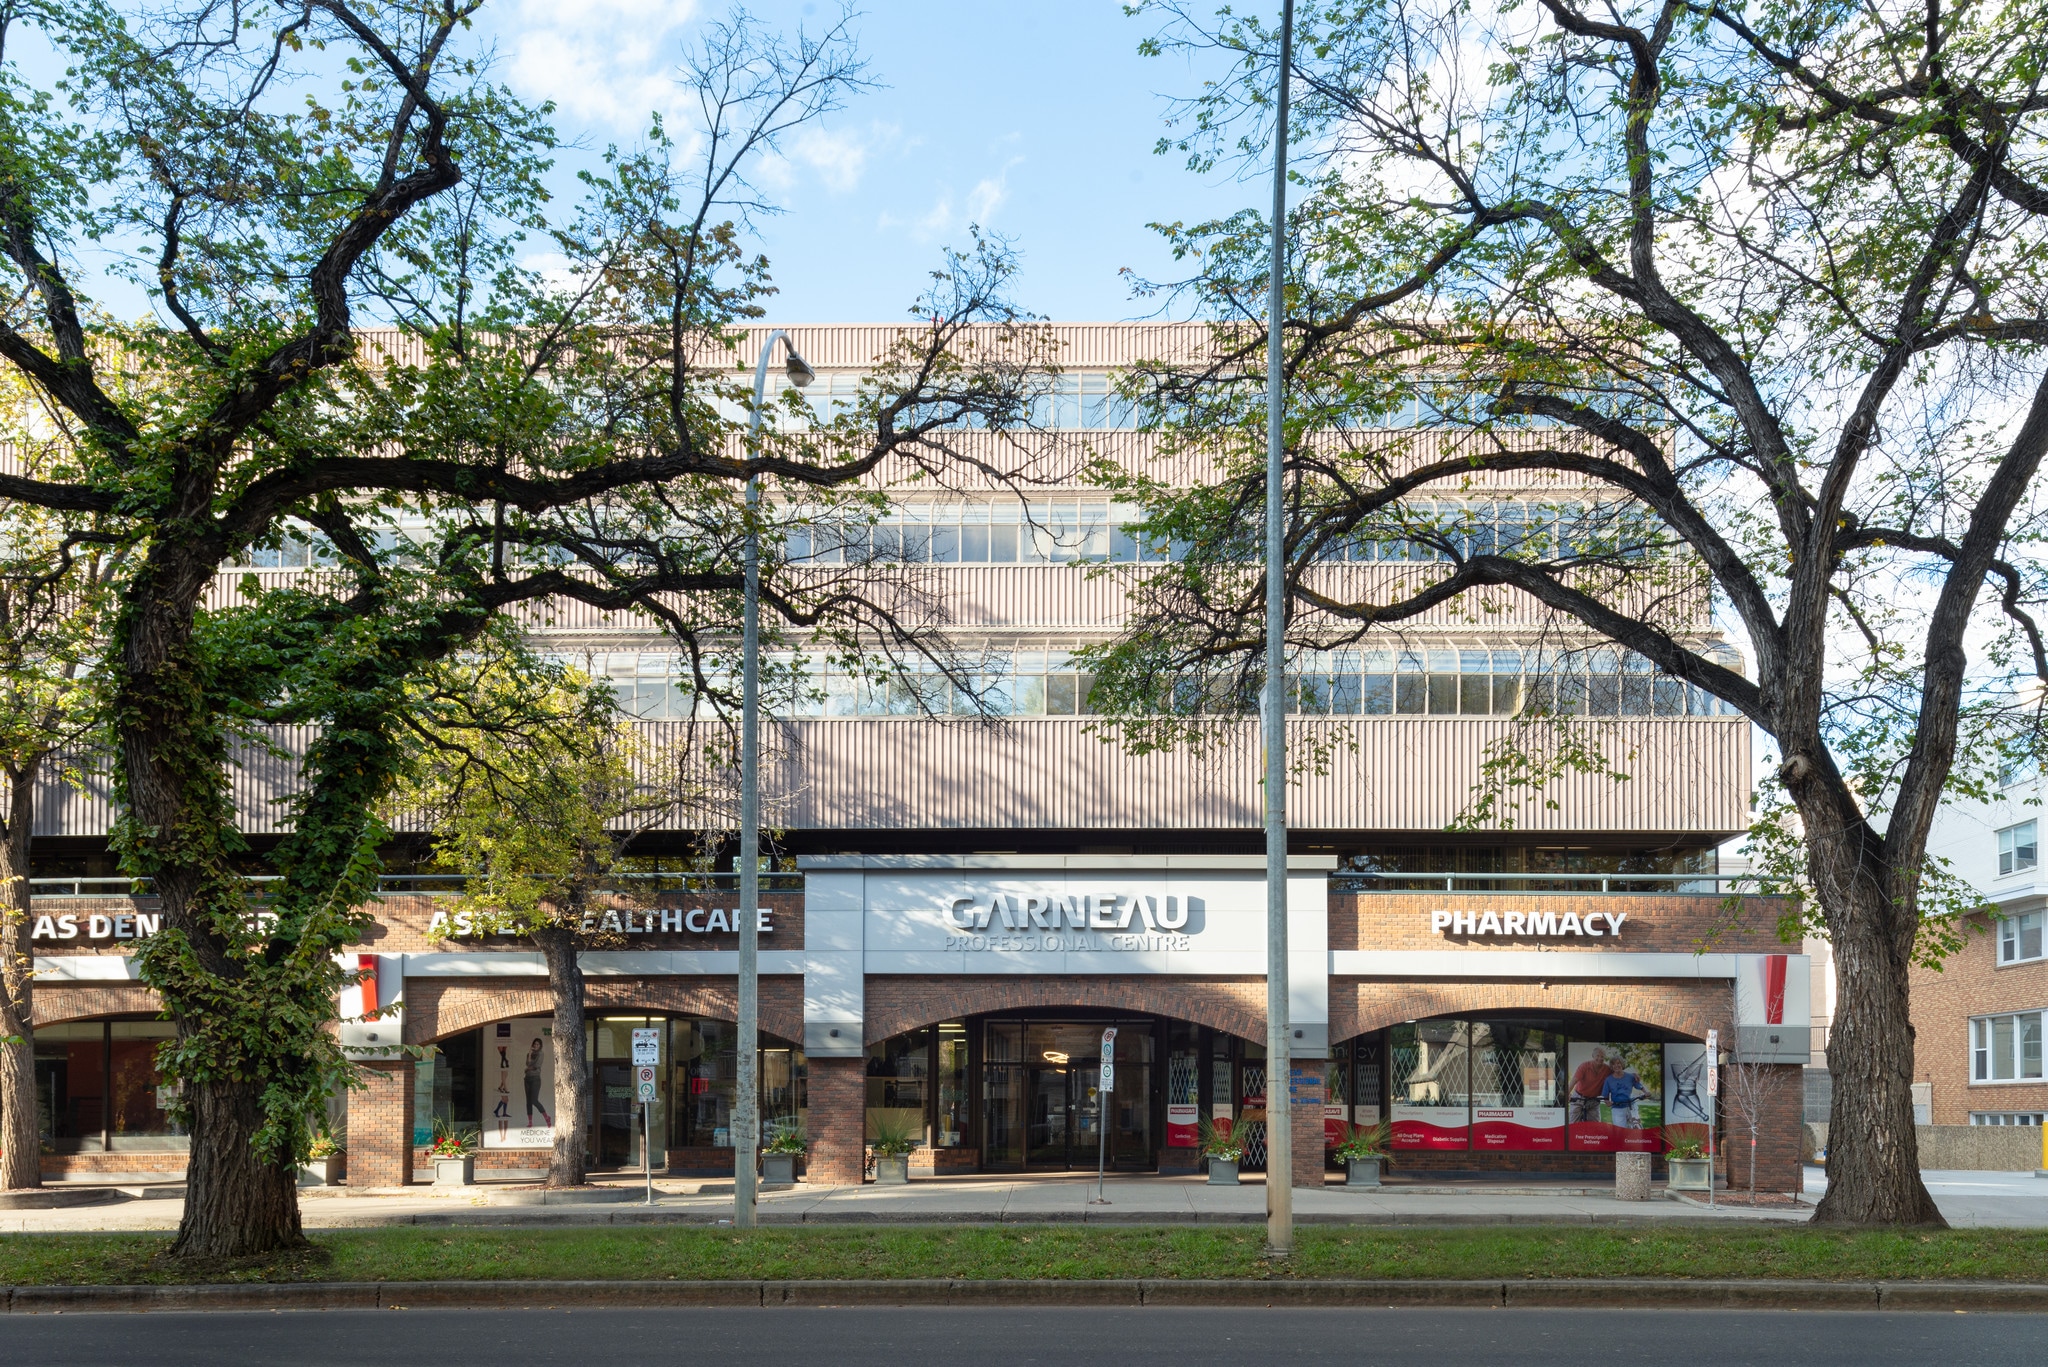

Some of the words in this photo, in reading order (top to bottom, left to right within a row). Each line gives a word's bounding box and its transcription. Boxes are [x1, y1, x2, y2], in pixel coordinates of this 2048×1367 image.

[579, 908, 774, 933] EALTHCAE
[942, 893, 1188, 930] GARNEAU
[1431, 911, 1627, 936] PHARMACY
[89, 914, 163, 938] DEN
[943, 934, 1101, 951] PROFESSIONAL
[1111, 934, 1190, 951] CENTRE
